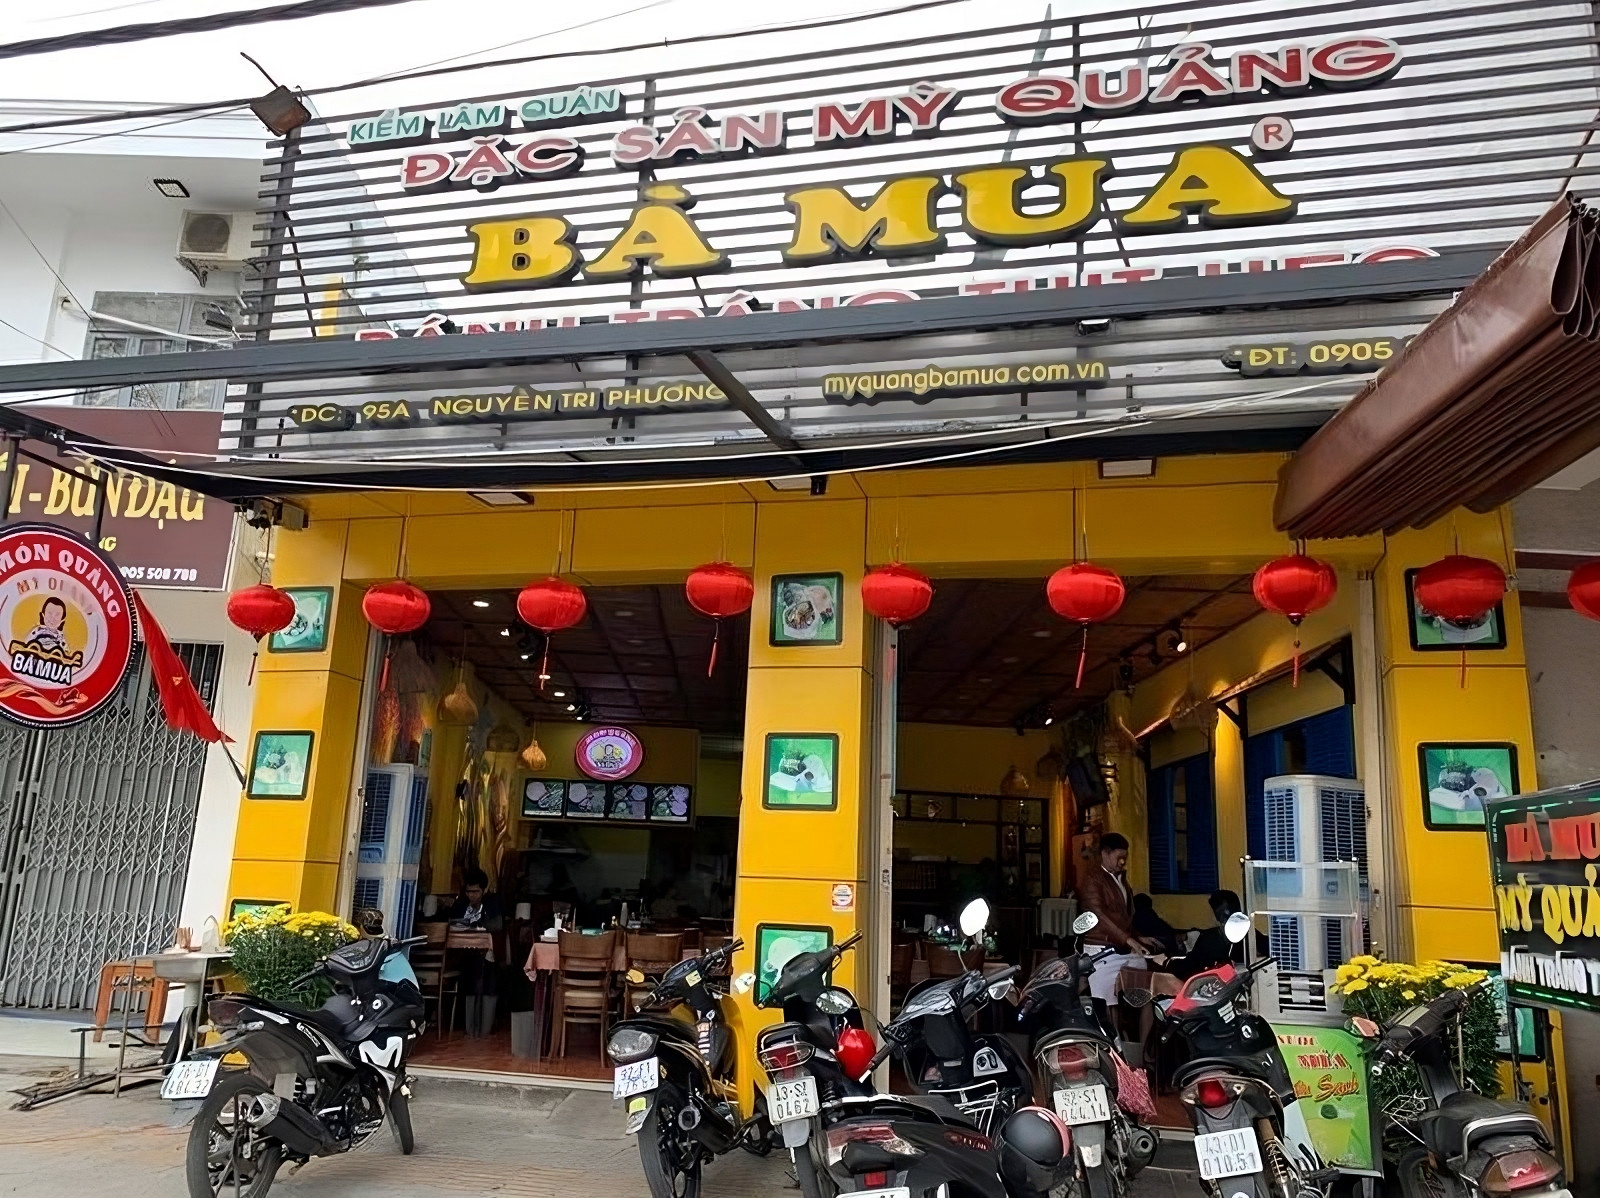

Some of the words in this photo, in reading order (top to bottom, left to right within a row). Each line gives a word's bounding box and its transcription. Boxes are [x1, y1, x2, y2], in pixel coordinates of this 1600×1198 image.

[401, 134, 579, 188] ĐẶC
[611, 106, 784, 164] SẢN
[995, 36, 1402, 119] QUẢNG
[438, 106, 500, 130] LÂM
[463, 184, 724, 286] BÀ
[786, 145, 1294, 258] MUA
[1310, 341, 1393, 363] 0905
[824, 361, 1105, 396] myquangbamua.com.vn
[362, 402, 411, 420] 95A
